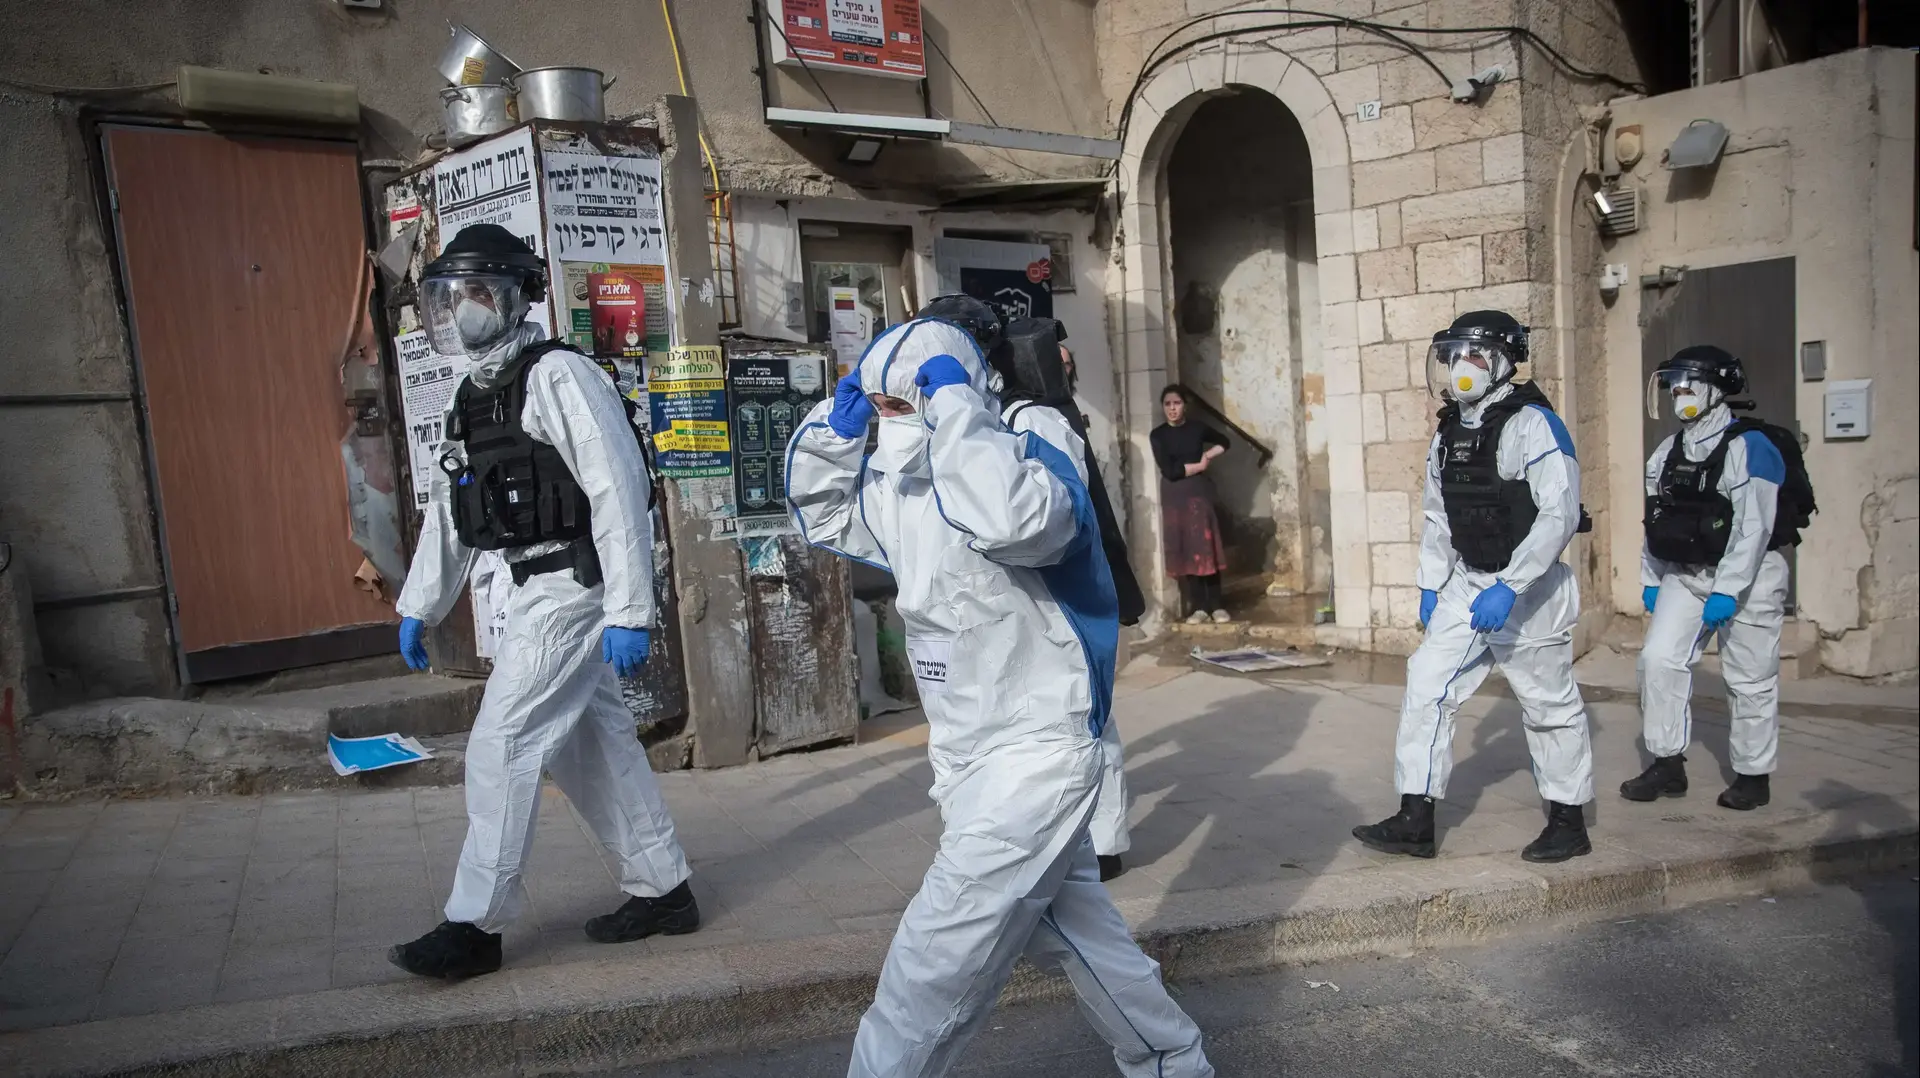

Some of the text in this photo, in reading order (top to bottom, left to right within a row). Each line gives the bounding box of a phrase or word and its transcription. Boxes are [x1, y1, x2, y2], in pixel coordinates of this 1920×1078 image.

[846, 1, 864, 12] סניף
[832, 10, 879, 24] מאה שערים
[1363, 104, 1374, 118] 12
[497, 146, 529, 189] ברוך
[471, 157, 494, 199] דיין
[548, 163, 579, 193] לפסח
[581, 166, 609, 189] חיים
[575, 193, 608, 204] המהדרין
[554, 223, 625, 256] קרפיון
[631, 225, 662, 249] דגי
[598, 284, 631, 296] אלא ביין
[401, 338, 415, 350] רחל
[667, 350, 715, 362] הדרך שלנו
[438, 365, 454, 378] אנשי
[652, 362, 713, 378] להצלחה שלך
[650, 383, 665, 391] כנסת
[916, 660, 947, 677] משטרה
